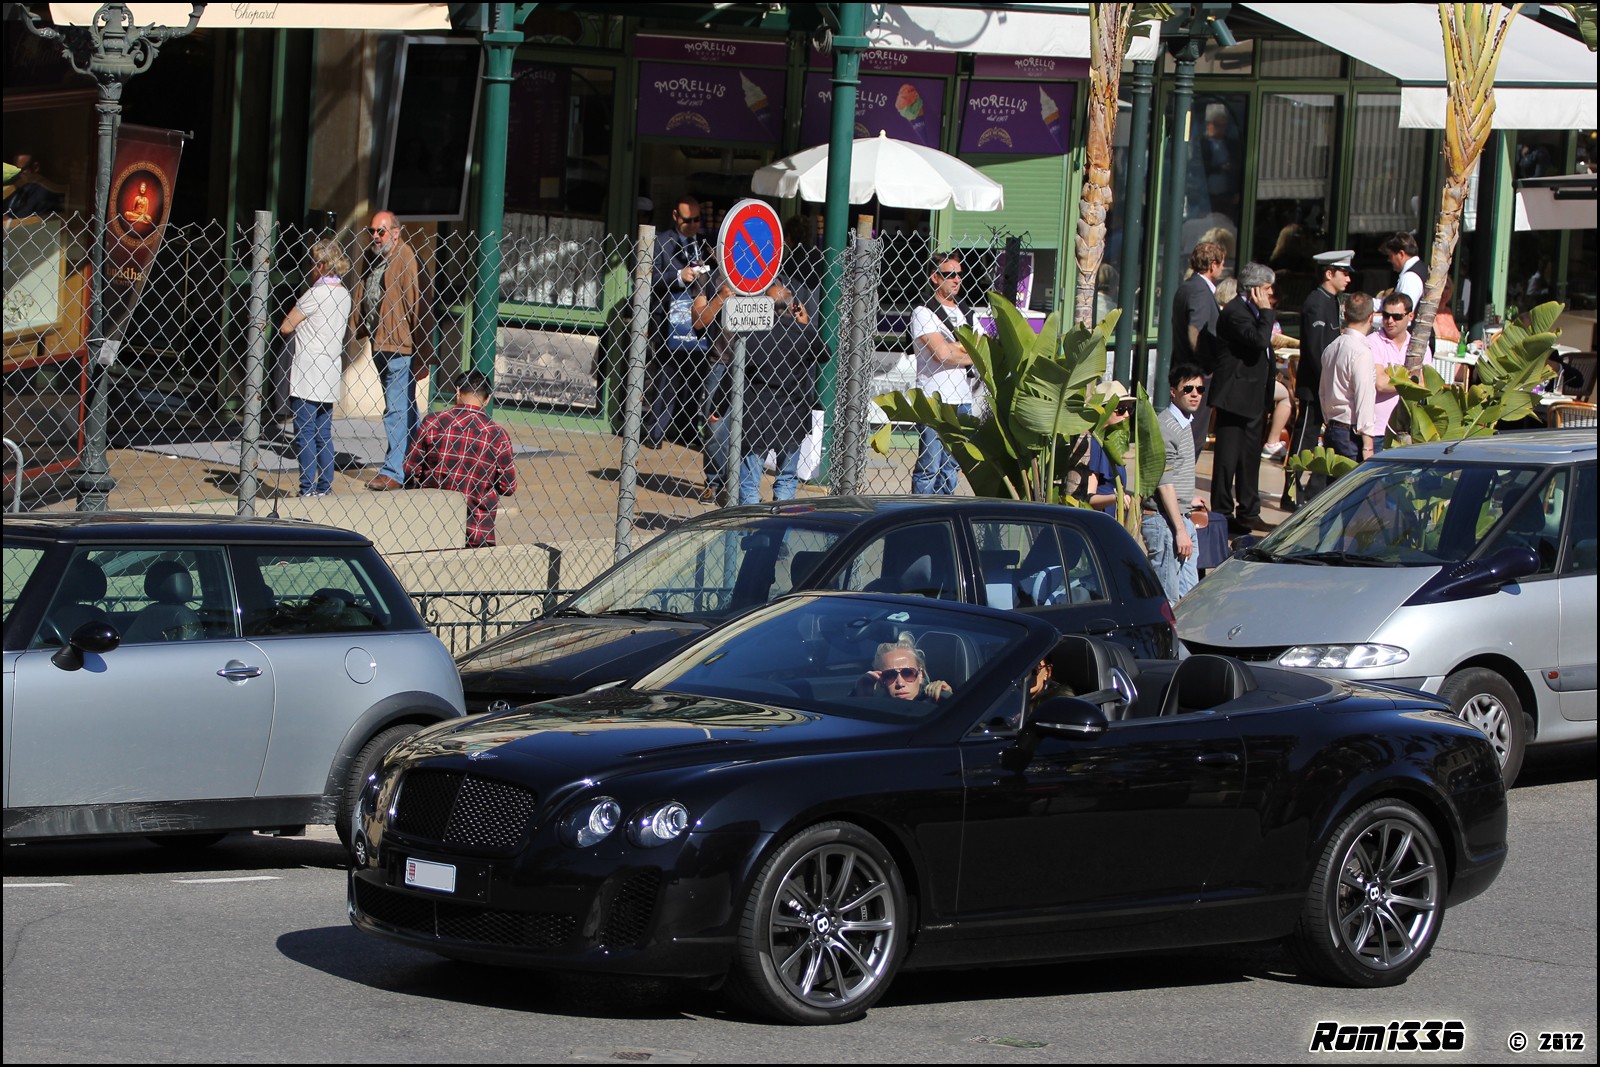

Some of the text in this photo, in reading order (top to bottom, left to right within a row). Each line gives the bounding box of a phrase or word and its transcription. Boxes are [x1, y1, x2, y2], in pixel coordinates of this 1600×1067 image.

[231, 3, 279, 24] Chopard
[685, 41, 737, 55] MORELLI'S
[861, 50, 908, 64] MORELLI'S
[1014, 57, 1056, 71] MORELLI'S
[654, 78, 726, 97] MORELLI'S
[670, 91, 712, 100] GELATO
[969, 94, 1028, 112] MORELLI'S
[735, 303, 768, 313] AUTORISE
[730, 316, 771, 327] 10 MINUTES
